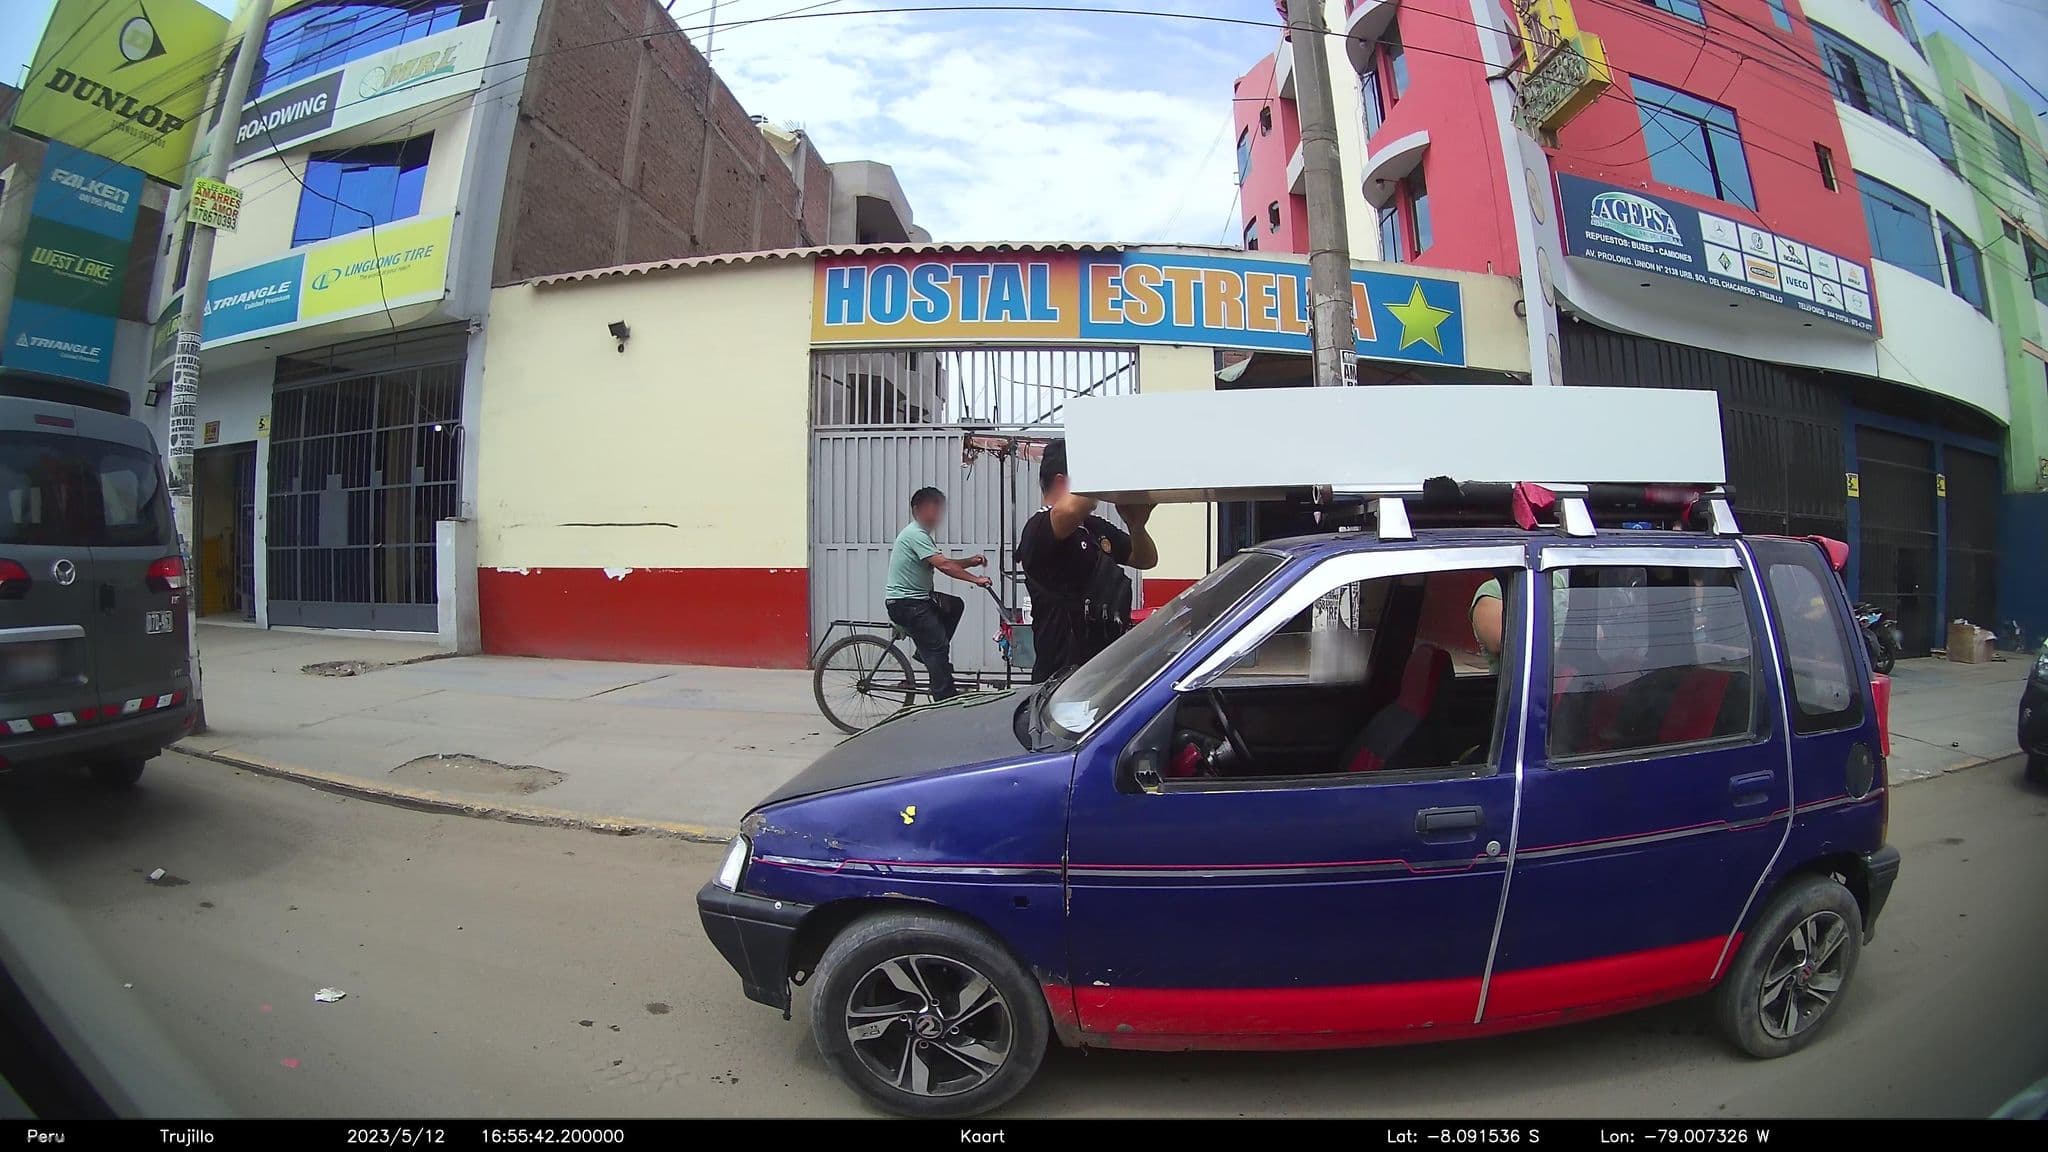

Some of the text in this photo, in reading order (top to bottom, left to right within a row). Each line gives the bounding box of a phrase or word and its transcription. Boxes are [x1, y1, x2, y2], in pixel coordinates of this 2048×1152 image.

[45, 67, 185, 134] DUNLOP
[236, 93, 328, 144] ROADWING
[50, 168, 130, 204] FALKEN
[195, 187, 242, 209] AMARRES
[211, 203, 239, 219] AMOR
[1599, 198, 1681, 240] AGEPSA
[345, 253, 401, 277] LINGLONG
[404, 245, 434, 262] TIRE
[1585, 231, 1631, 248] REPUESTOS:
[1631, 241, 1654, 254] BUSES
[1659, 247, 1693, 263] CAMIONES
[1585, 249, 1596, 258] AV.
[1695, 273, 1708, 283] SOL
[1709, 277, 1721, 287] DEL
[1759, 290, 1784, 304] TRUJILLO
[1785, 276, 1809, 290] IVECO
[212, 281, 292, 311] TRIANGLE
[825, 263, 1377, 342] HOSTAL ESTRELA
[30, 336, 101, 356] TRIANGLE
